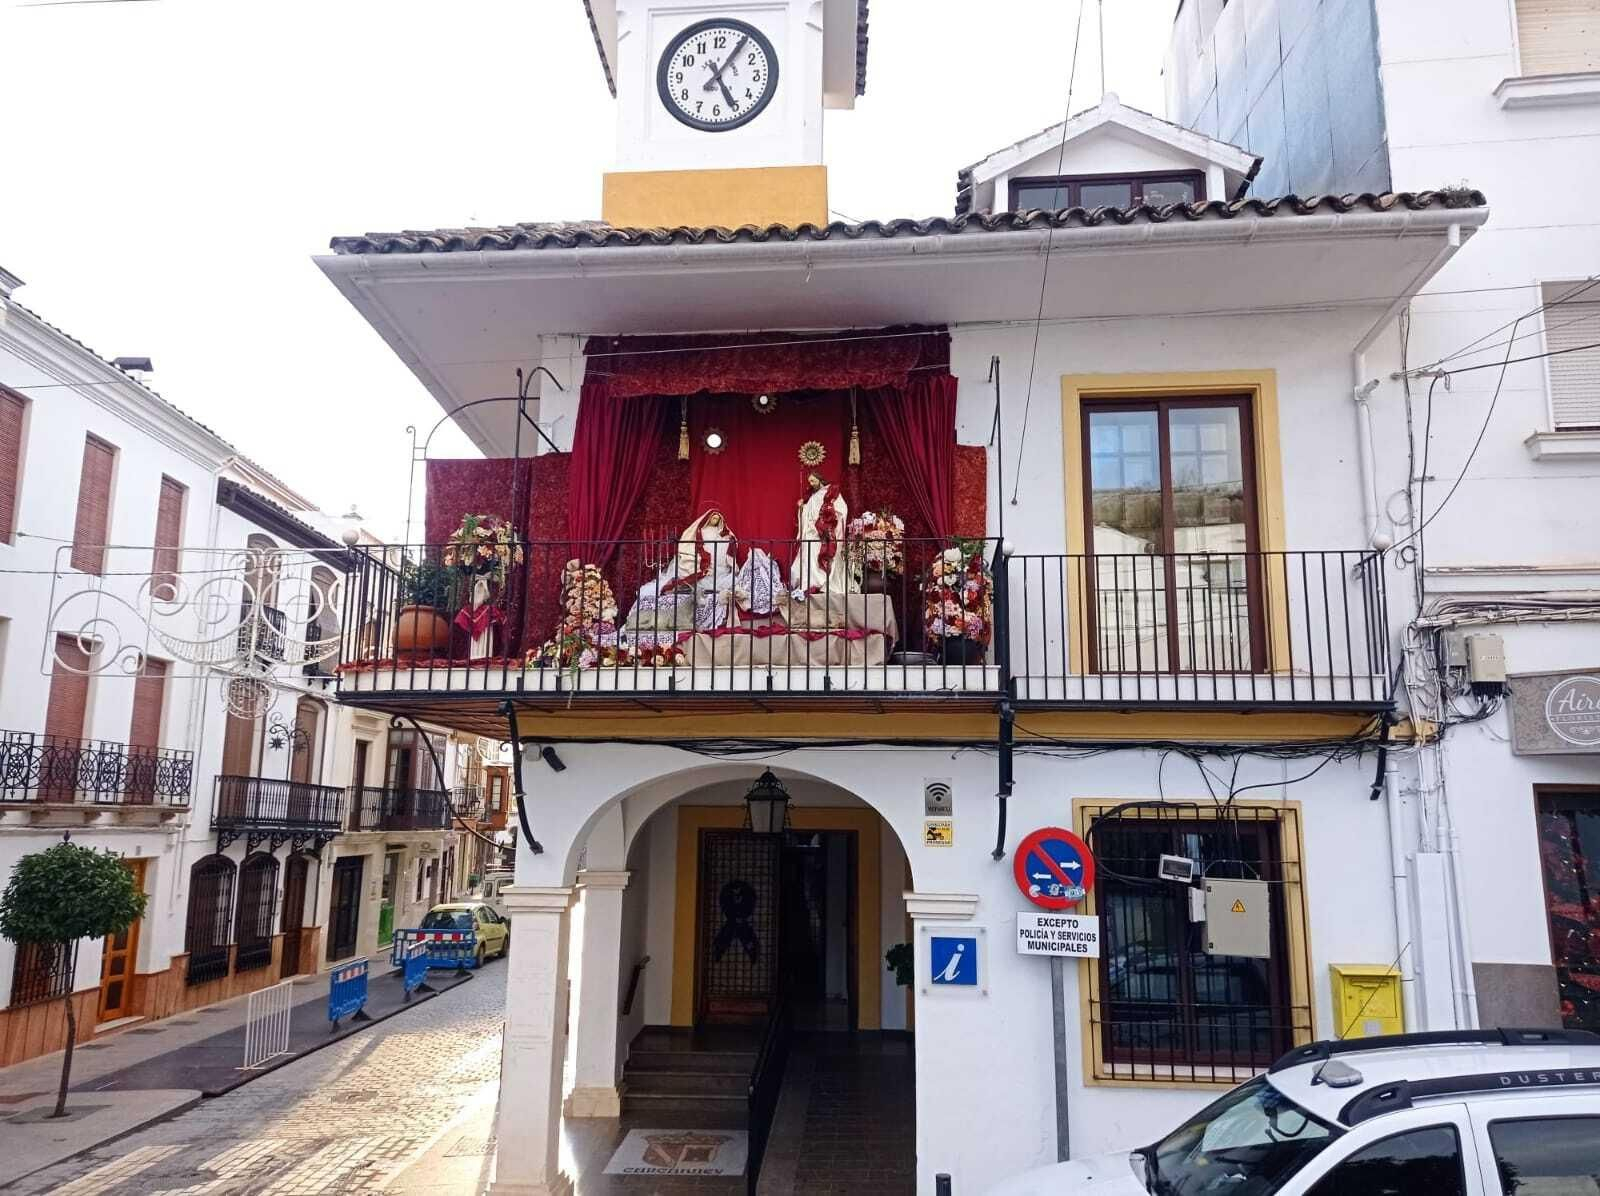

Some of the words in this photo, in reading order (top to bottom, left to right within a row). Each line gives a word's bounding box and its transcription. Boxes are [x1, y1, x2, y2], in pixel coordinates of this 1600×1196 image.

[697, 42, 706, 54] 11
[713, 36, 727, 49] 12
[682, 55, 695, 67] 10
[747, 53, 756, 65] 2
[675, 72, 684, 84] 9
[752, 69, 761, 82] 3
[681, 88, 689, 101] 8
[744, 88, 753, 100] 4
[695, 101, 703, 113] 7
[712, 104, 721, 116] 6
[732, 100, 740, 112] 5
[1037, 917, 1079, 929] EXCEPTO
[1019, 928, 1049, 940] POLICÍA
[1050, 930, 1056, 940] Y
[1057, 931, 1097, 943] SERVICIOS
[1027, 940, 1088, 953] MUNICIPALES
[1500, 1071, 1600, 1085] DUSTER
